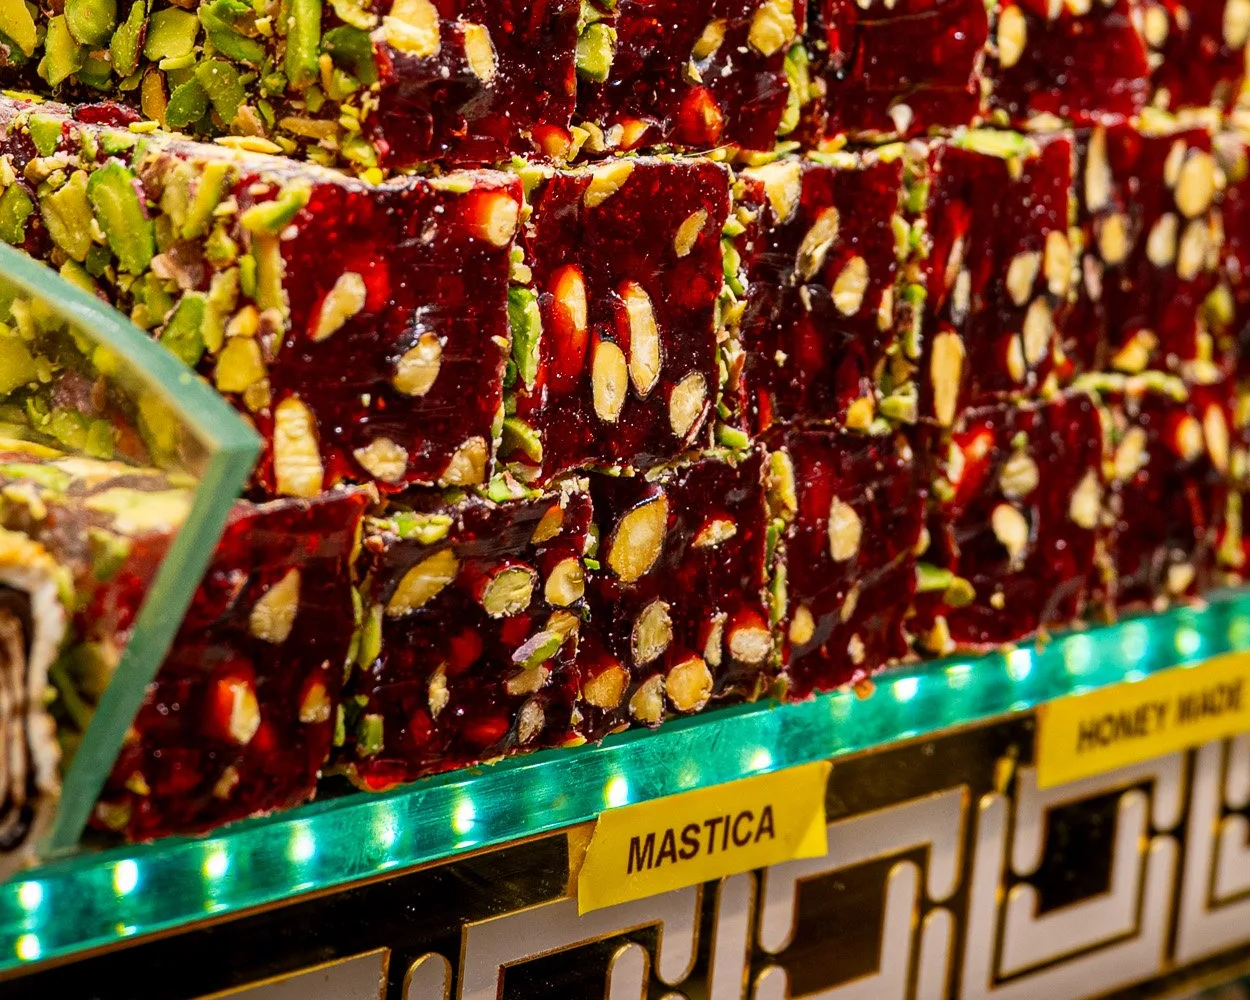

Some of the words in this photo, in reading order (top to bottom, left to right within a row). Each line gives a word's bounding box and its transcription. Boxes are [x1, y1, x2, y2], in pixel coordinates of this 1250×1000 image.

[1077, 702, 1167, 754] HONEY
[1175, 677, 1244, 725] MADE
[627, 804, 776, 875] MASTICA
